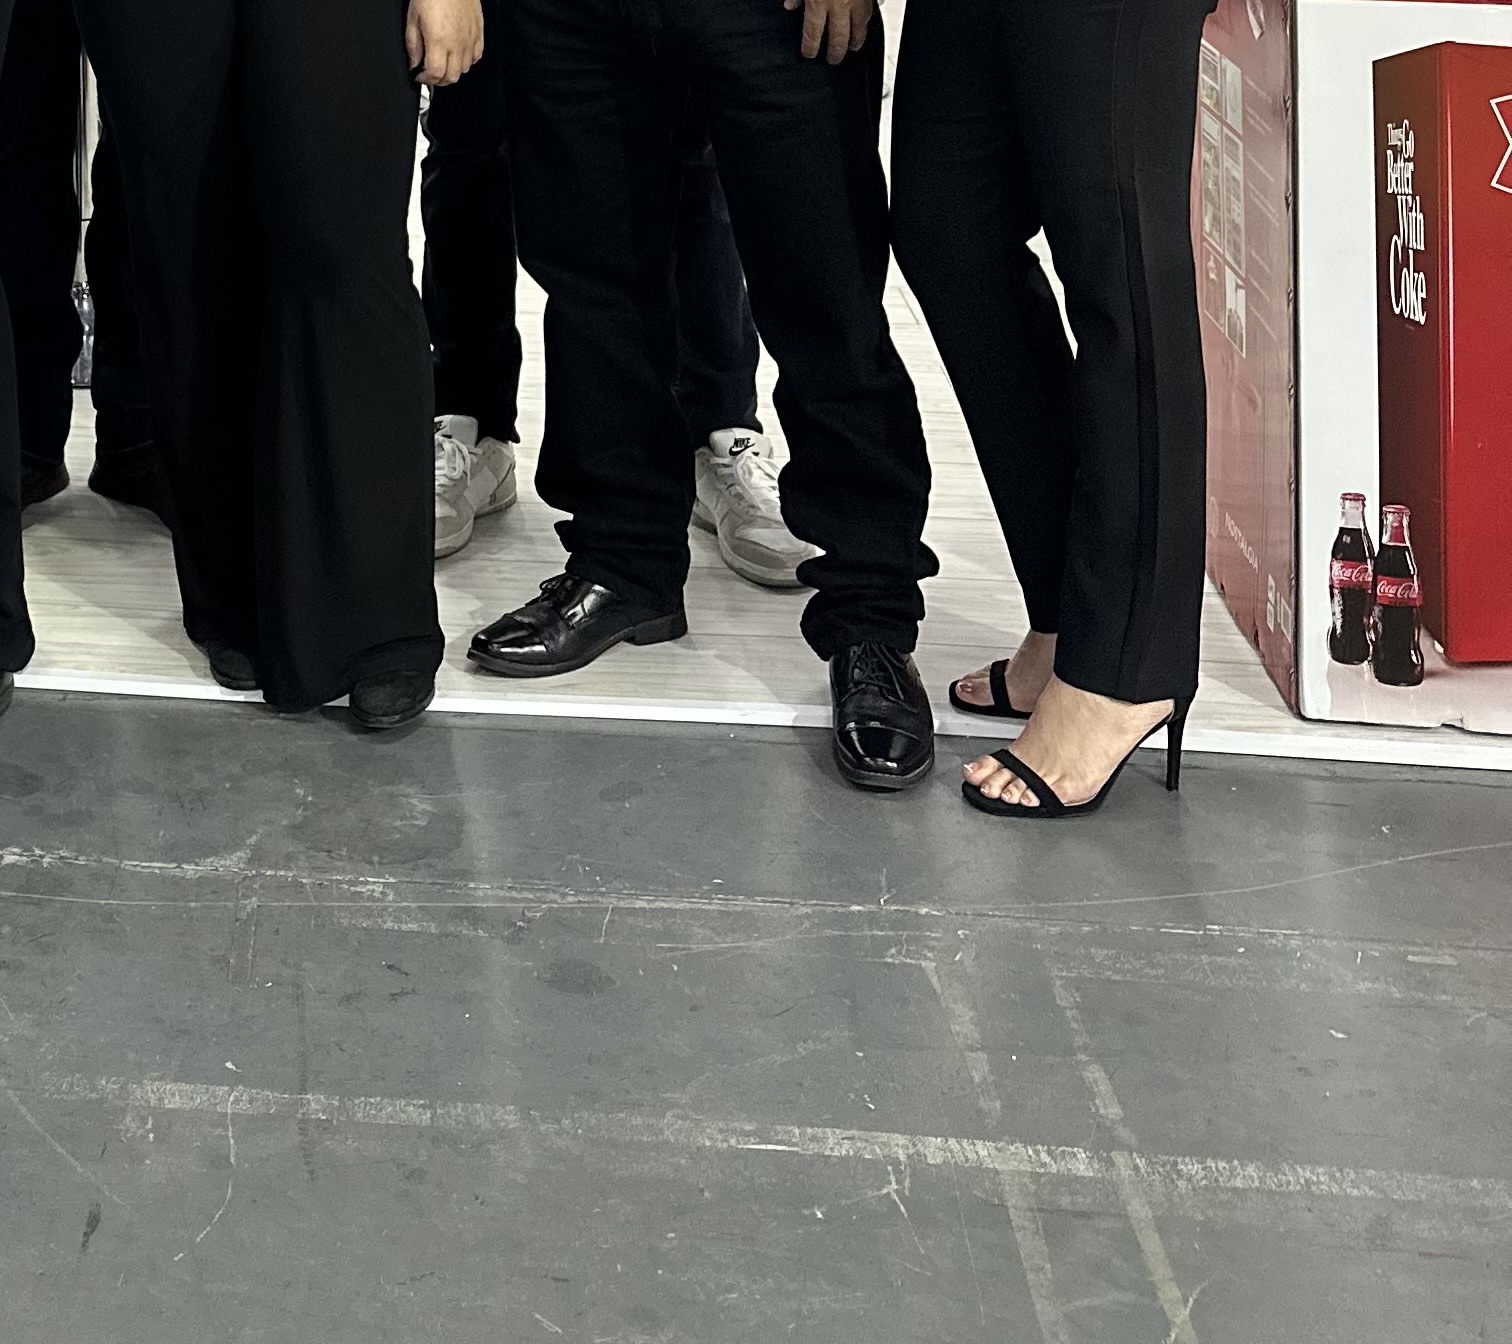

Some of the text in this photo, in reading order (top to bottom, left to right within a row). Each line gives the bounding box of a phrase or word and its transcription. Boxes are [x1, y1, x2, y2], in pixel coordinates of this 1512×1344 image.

[1402, 119, 1415, 159] Go
[1387, 149, 1414, 194] Better
[1397, 195, 1425, 251] With
[1389, 235, 1427, 326] Coke
